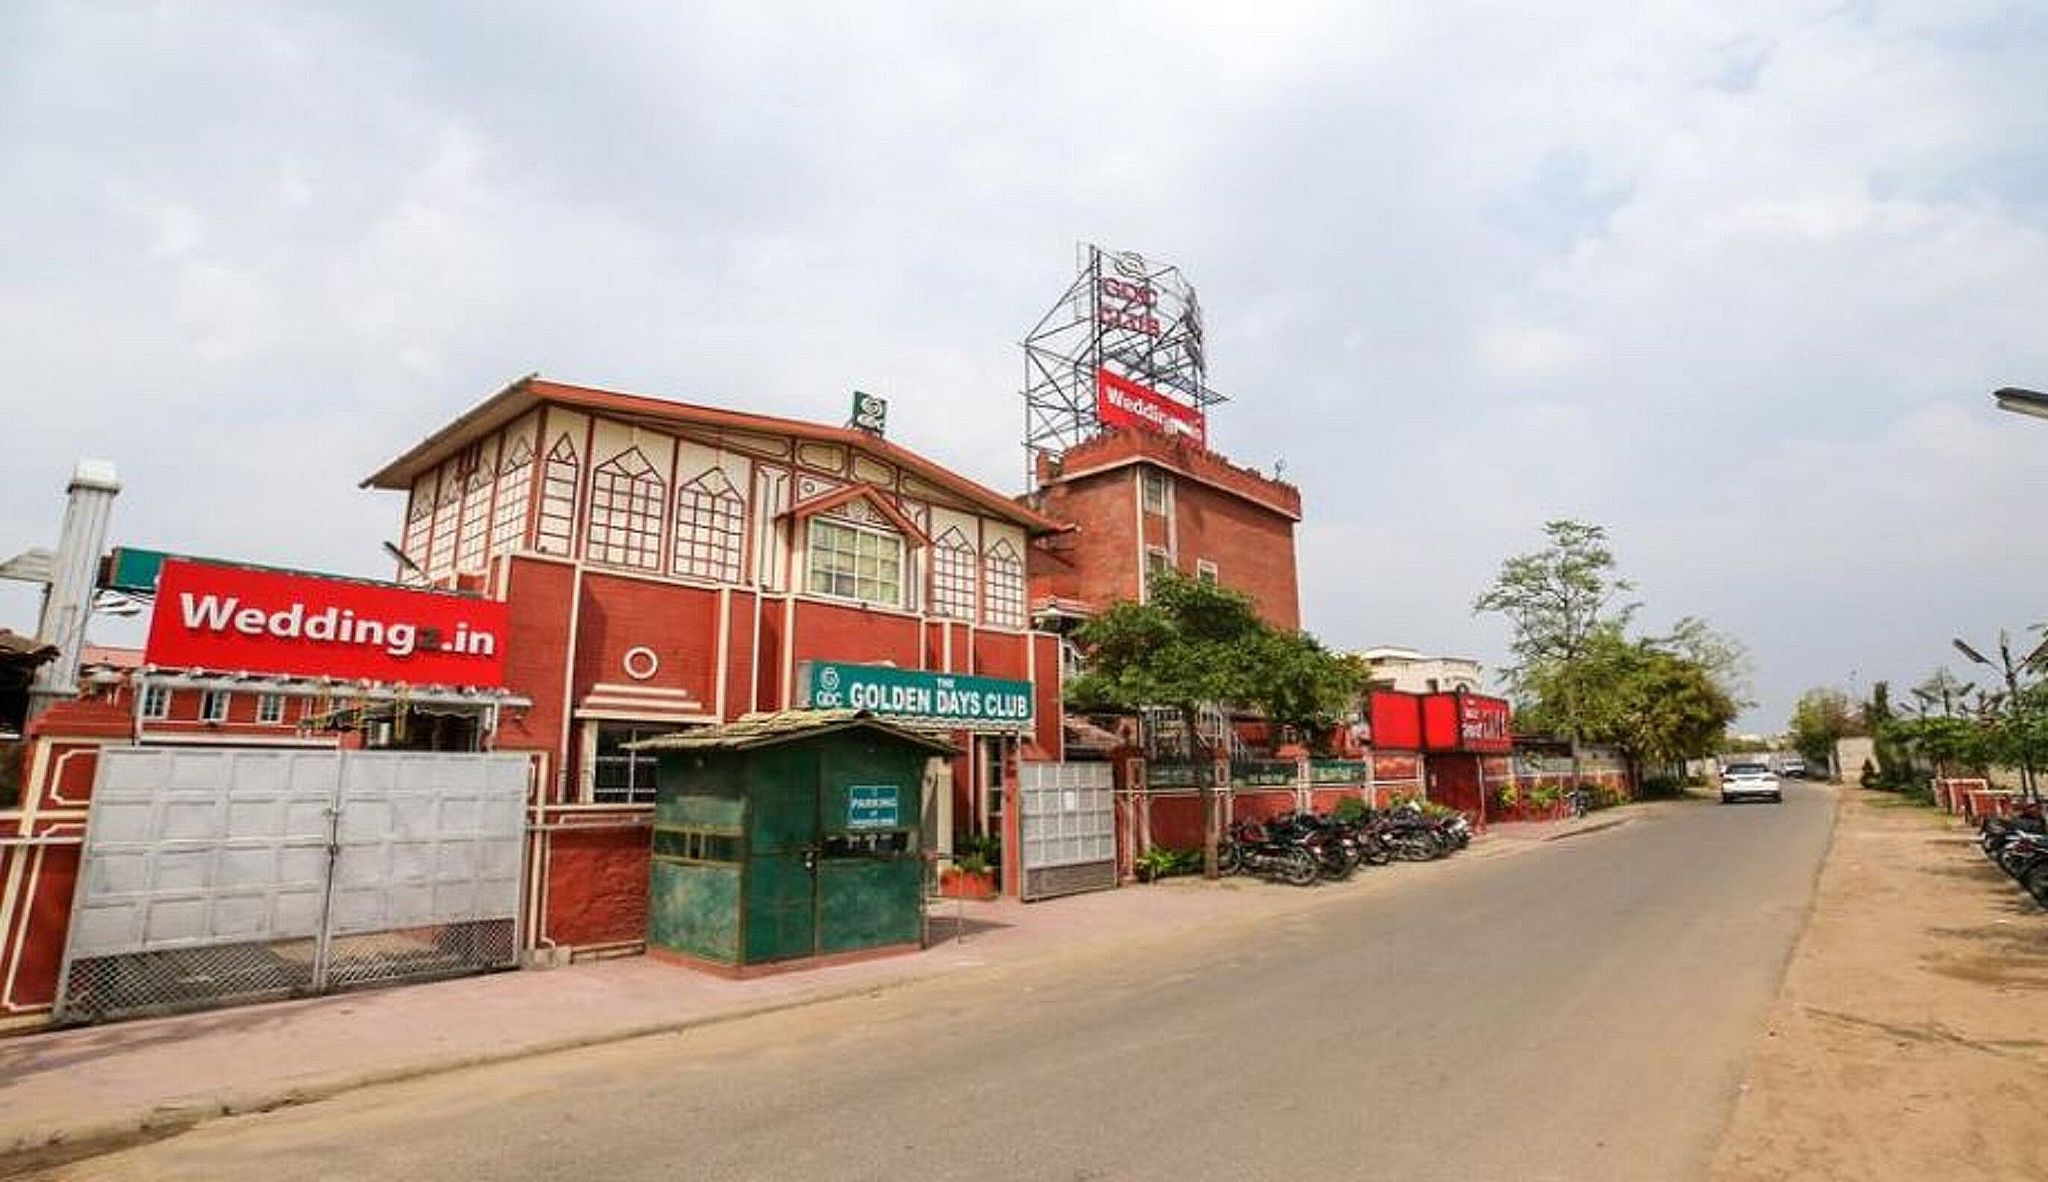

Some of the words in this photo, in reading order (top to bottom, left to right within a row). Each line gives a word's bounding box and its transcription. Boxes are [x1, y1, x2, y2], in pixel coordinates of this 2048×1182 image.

[850, 682, 931, 713] GOLDEN
[936, 690, 981, 716] DAYS
[985, 694, 1028, 718] CLUB
